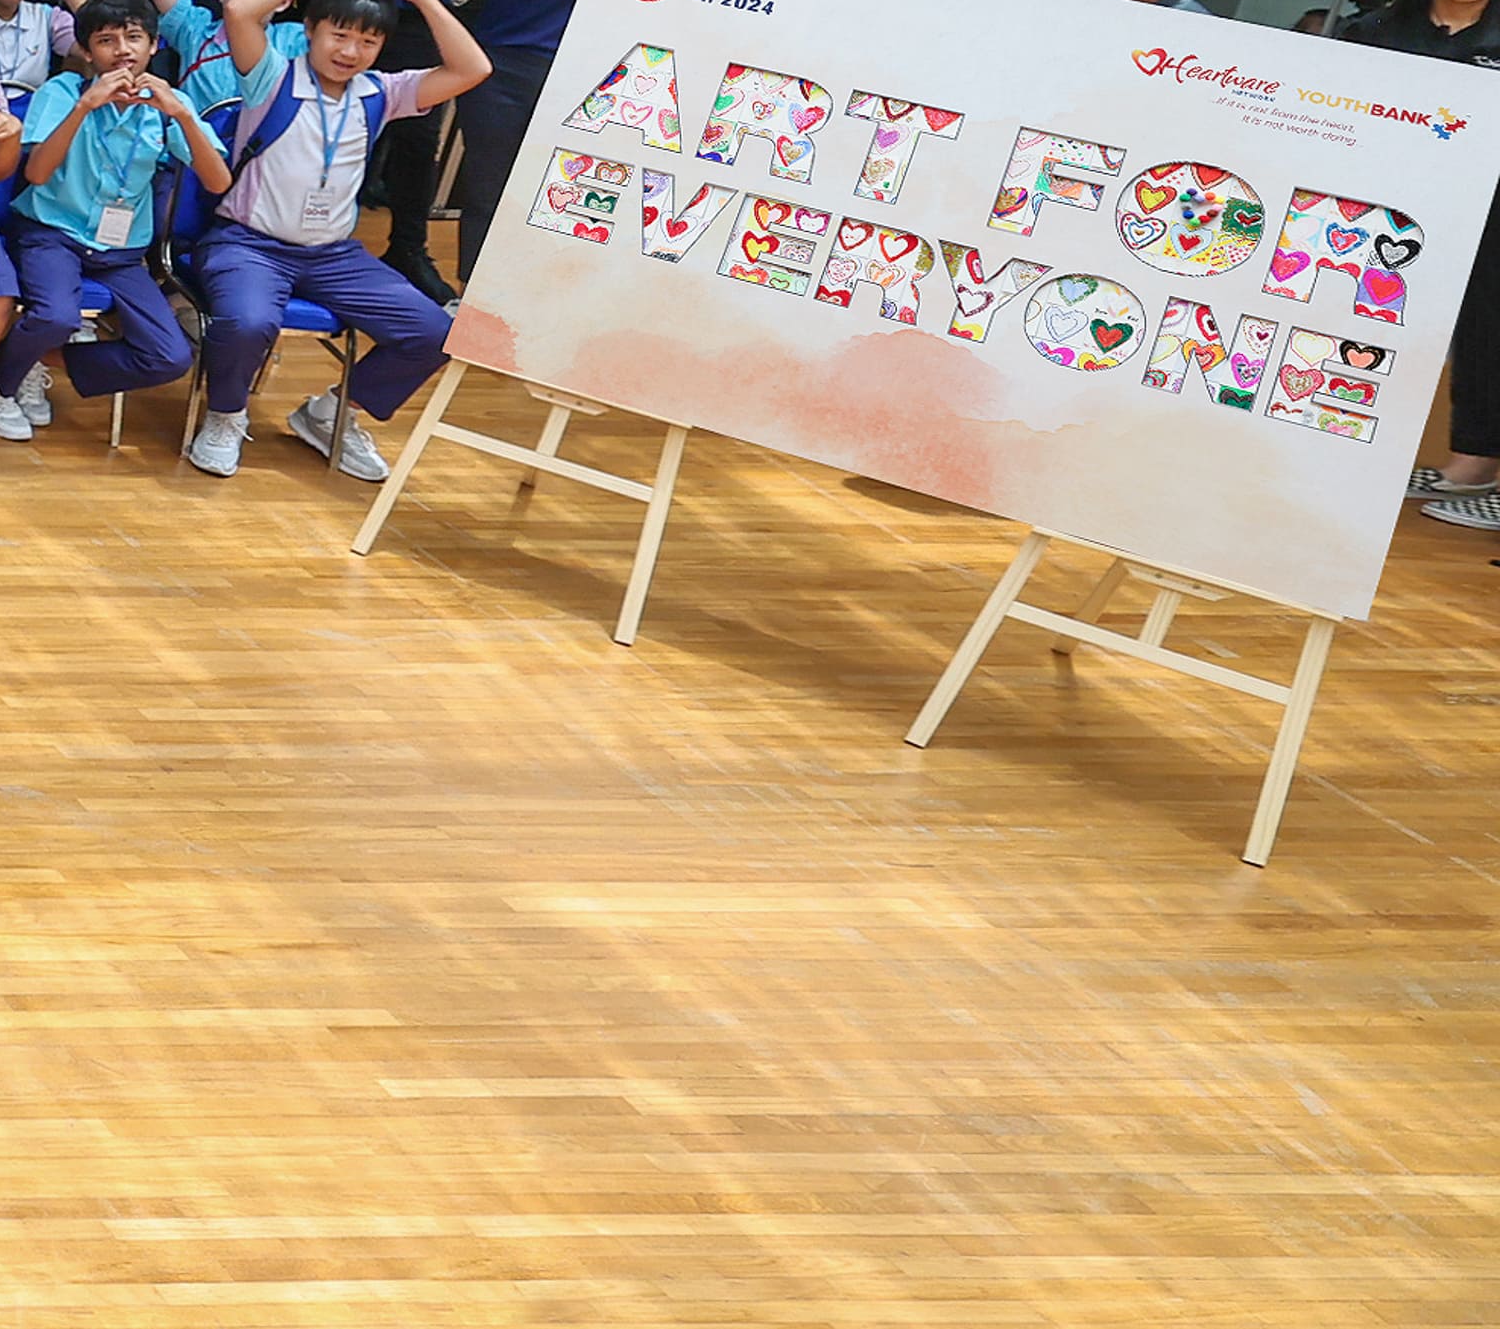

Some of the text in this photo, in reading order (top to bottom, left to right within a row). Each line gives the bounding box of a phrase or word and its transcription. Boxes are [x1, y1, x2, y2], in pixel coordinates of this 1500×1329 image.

[1162, 54, 1283, 96] Heartware
[1296, 87, 1433, 128] YOUTHBANK
[560, 42, 1427, 327] ART FOR
[526, 146, 1398, 446] EVERYONE
